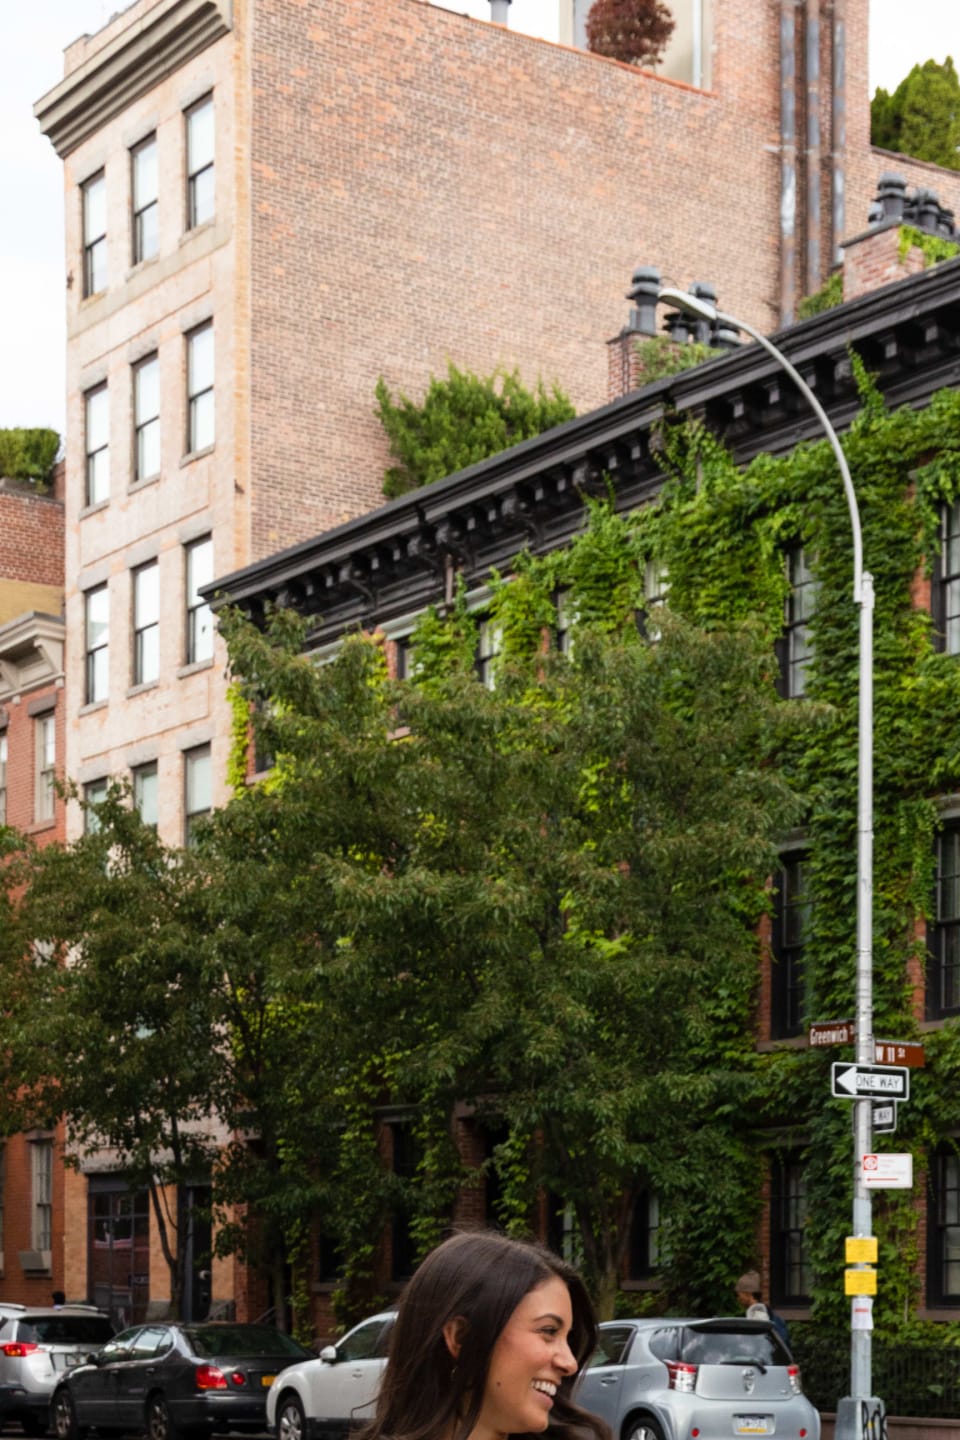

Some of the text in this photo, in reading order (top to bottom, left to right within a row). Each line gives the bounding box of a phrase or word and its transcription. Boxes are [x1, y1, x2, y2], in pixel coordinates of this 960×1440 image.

[810, 1025, 848, 1045] Greenwich
[875, 1045, 884, 1062] W
[887, 1046, 896, 1063] 11
[856, 1074, 900, 1089] ONE WAY
